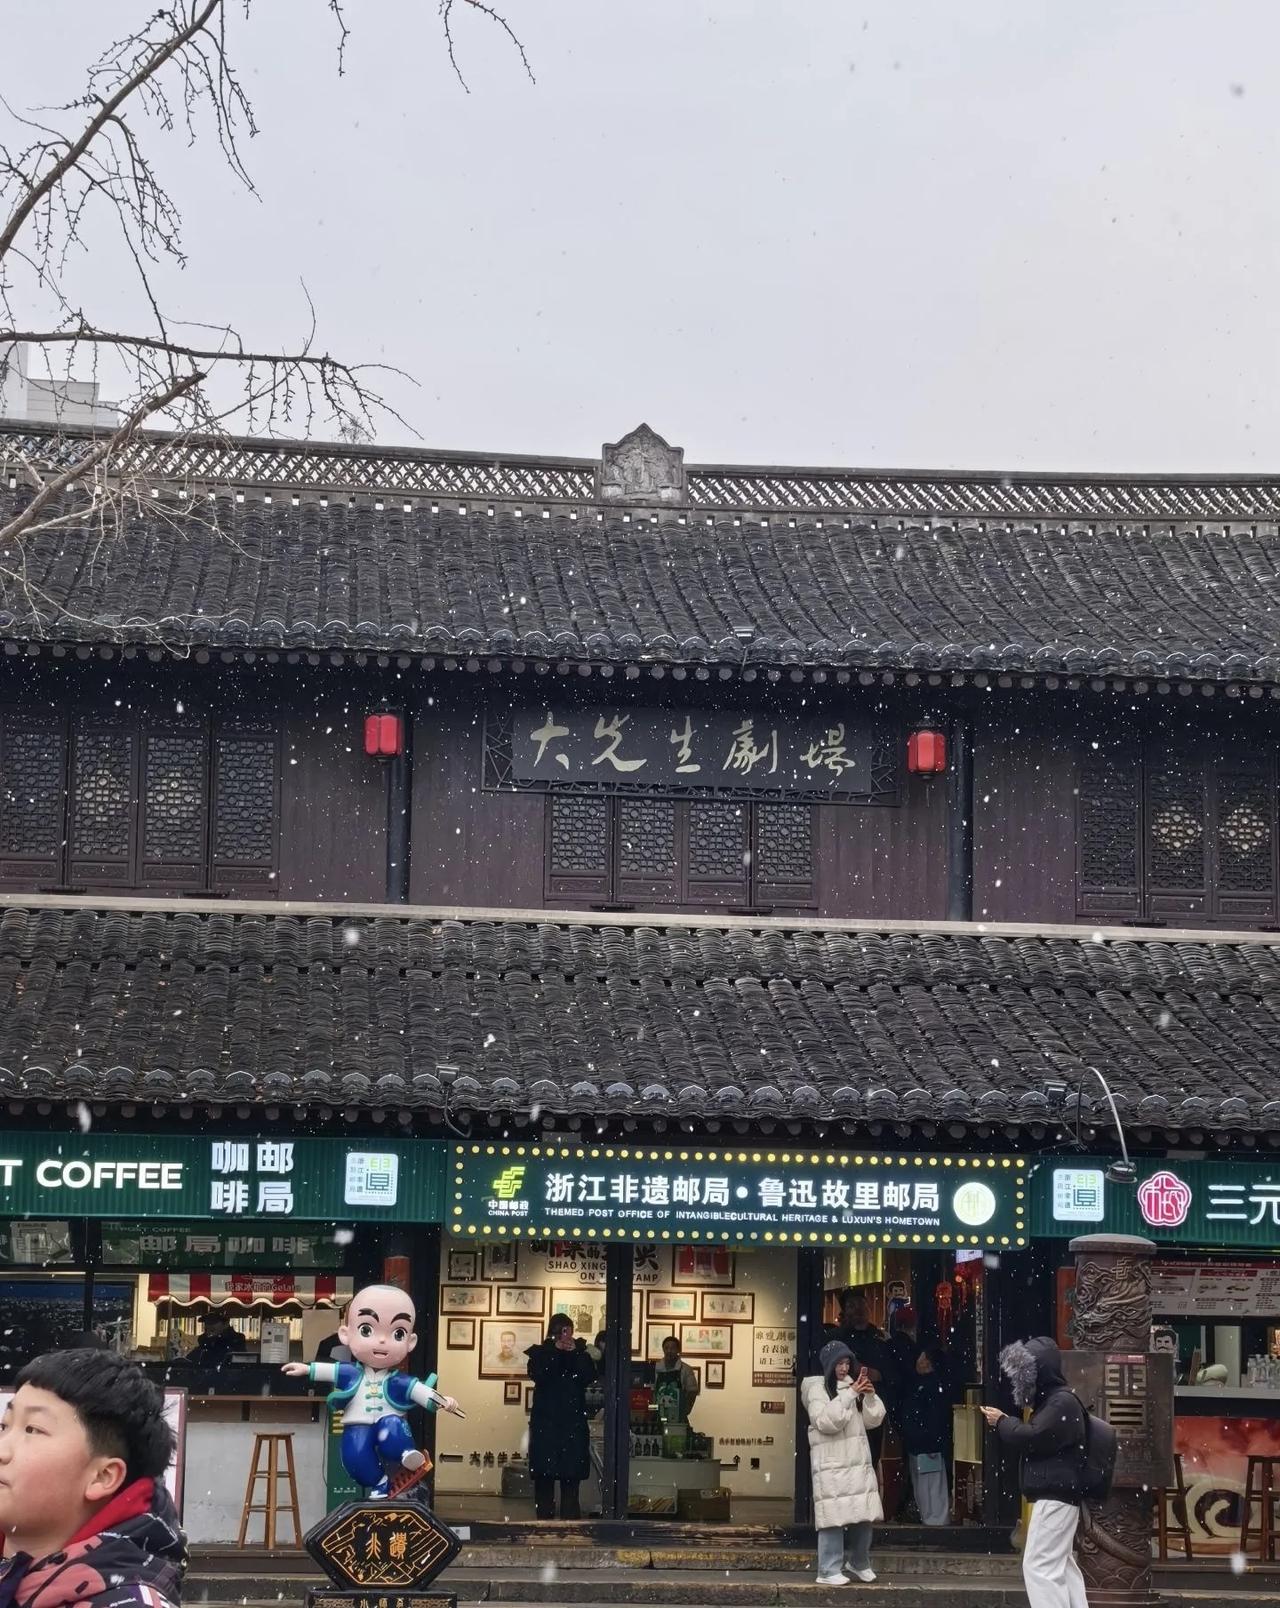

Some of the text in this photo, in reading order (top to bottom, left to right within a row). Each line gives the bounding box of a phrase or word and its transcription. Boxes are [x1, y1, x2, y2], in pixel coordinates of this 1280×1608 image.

[36, 1159, 183, 1189] COFFEE
[544, 1207, 584, 1217] THEMED
[589, 1209, 614, 1218] POST
[618, 1209, 653, 1218] OFFICE
[657, 1210, 670, 1219] OF
[782, 1213, 828, 1223] HERITAGE
[831, 1214, 838, 1223] &
[842, 1215, 882, 1225] LUXUN'S
[885, 1217, 940, 1227] HOMETOWN
[139, 1235, 314, 1255] 邮局咖啡
[548, 1261, 606, 1270] SHAO XING
[580, 1272, 595, 1280] ON
[633, 1273, 659, 1282] AMP
